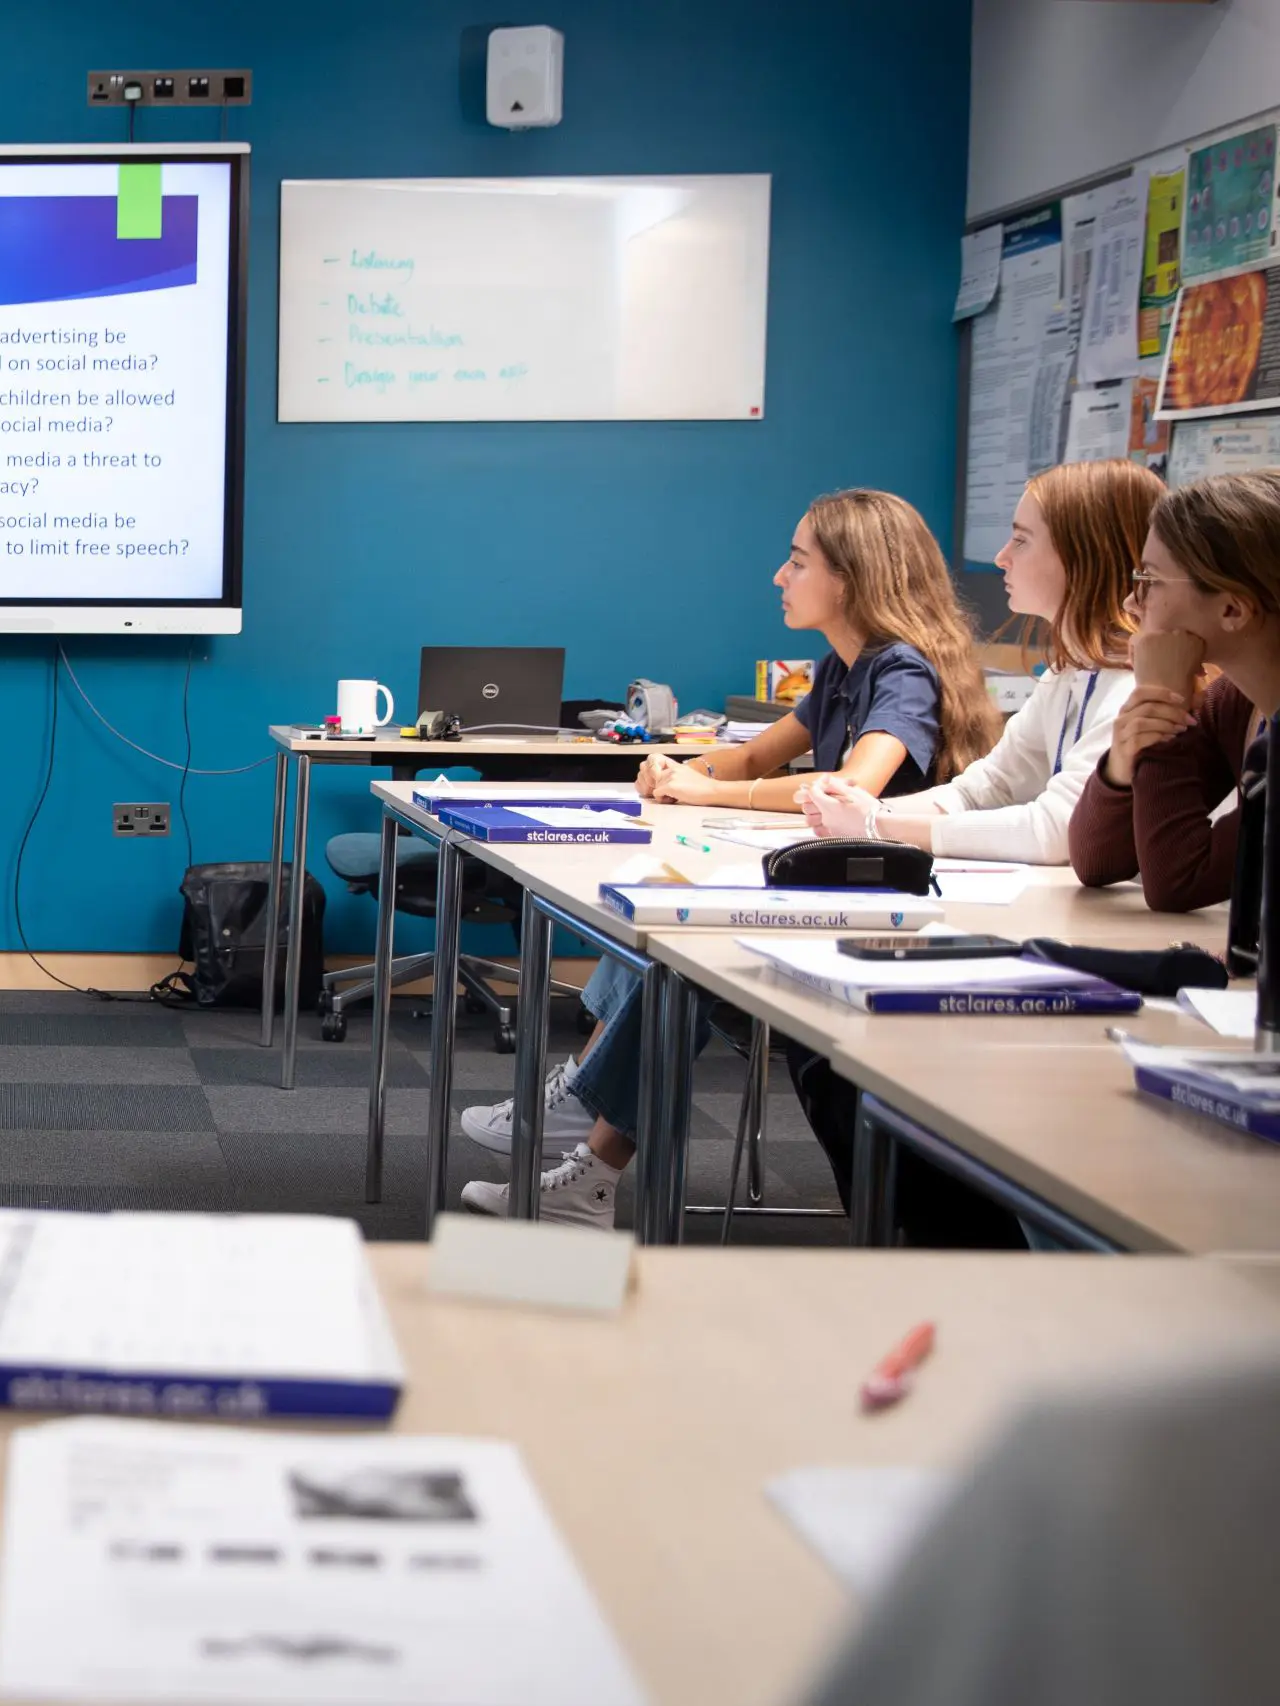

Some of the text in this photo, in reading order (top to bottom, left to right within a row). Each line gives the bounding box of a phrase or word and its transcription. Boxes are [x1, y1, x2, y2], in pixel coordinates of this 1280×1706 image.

[347, 292, 404, 318] Debate
[0, 328, 99, 348] advertising
[105, 328, 126, 344] be
[8, 359, 30, 371] on
[36, 354, 86, 371] social
[93, 354, 158, 371] media?
[0, 389, 71, 406] children
[78, 389, 99, 406] be
[105, 389, 176, 406] allowed
[48, 416, 113, 433] media?
[7, 451, 61, 467] media
[67, 455, 77, 467] a
[83, 451, 137, 467] threat
[144, 453, 162, 467] to
[53, 512, 108, 528] media
[115, 512, 136, 528] be
[7, 541, 24, 555] to
[30, 538, 70, 555] limit
[76, 538, 110, 555] free
[116, 539, 189, 559] speech?
[526, 830, 610, 843] stclares.ac.uk
[729, 910, 849, 928] stclares.ac.uk
